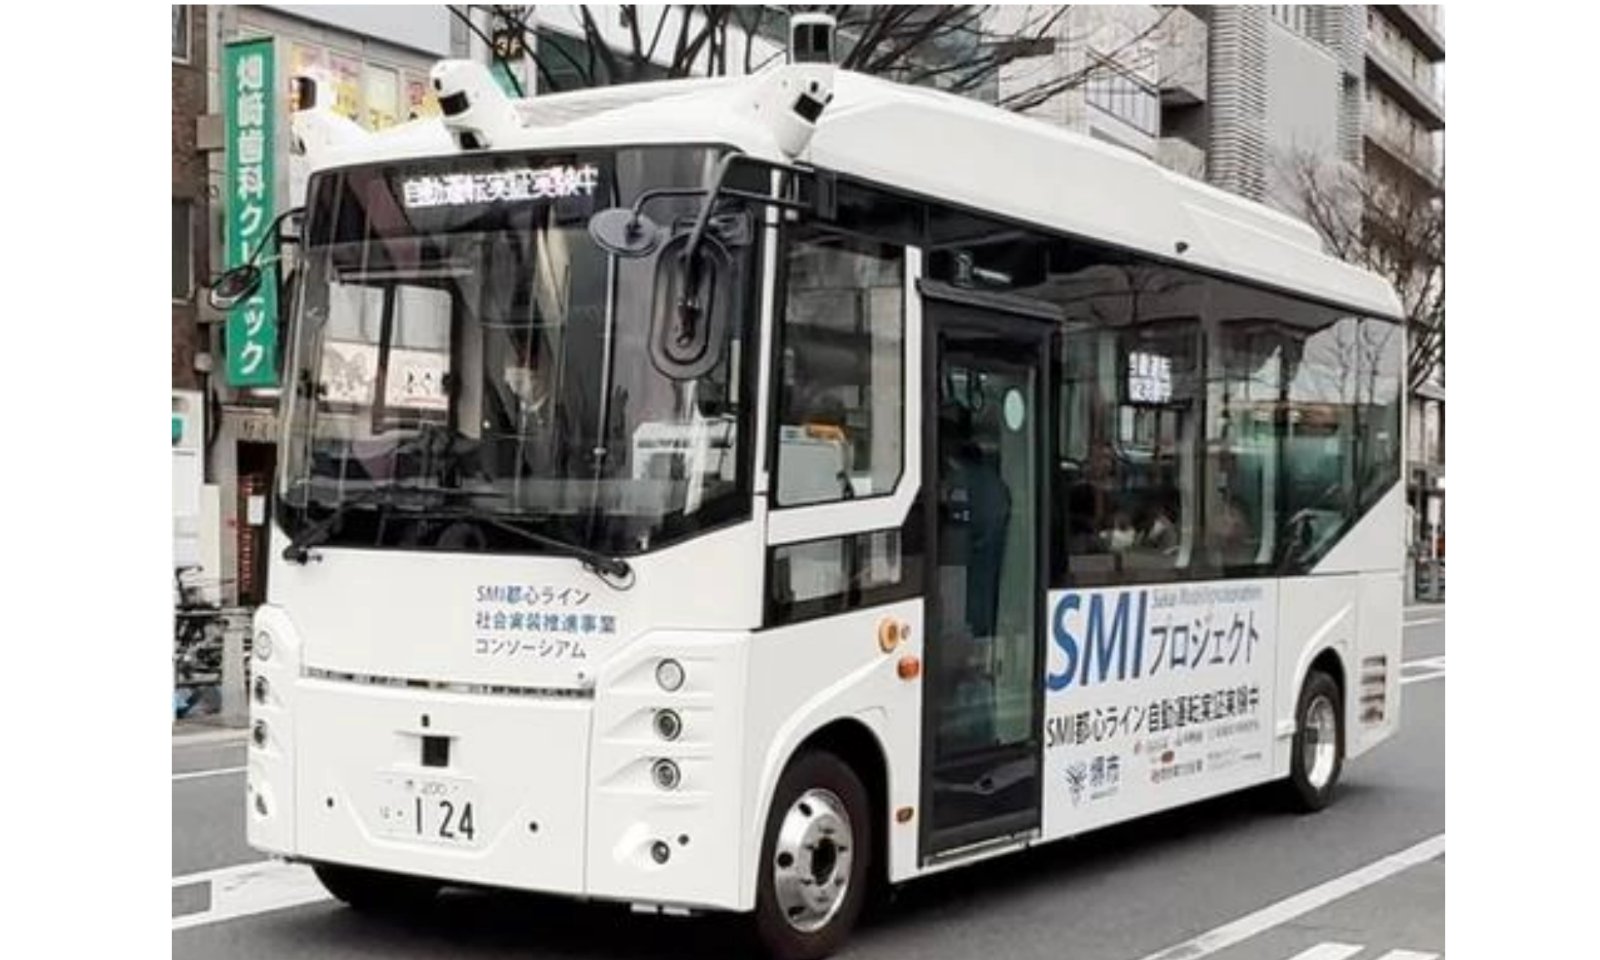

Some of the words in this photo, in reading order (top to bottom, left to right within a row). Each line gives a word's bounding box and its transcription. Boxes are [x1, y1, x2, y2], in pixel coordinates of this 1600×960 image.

[476, 584, 591, 606] SMI都心ライン
[475, 610, 617, 634] 社会実装推進事業
[475, 638, 586, 659] コンソーシアム
[1046, 589, 1148, 692] SMI
[1148, 609, 1259, 676] プロジェクト
